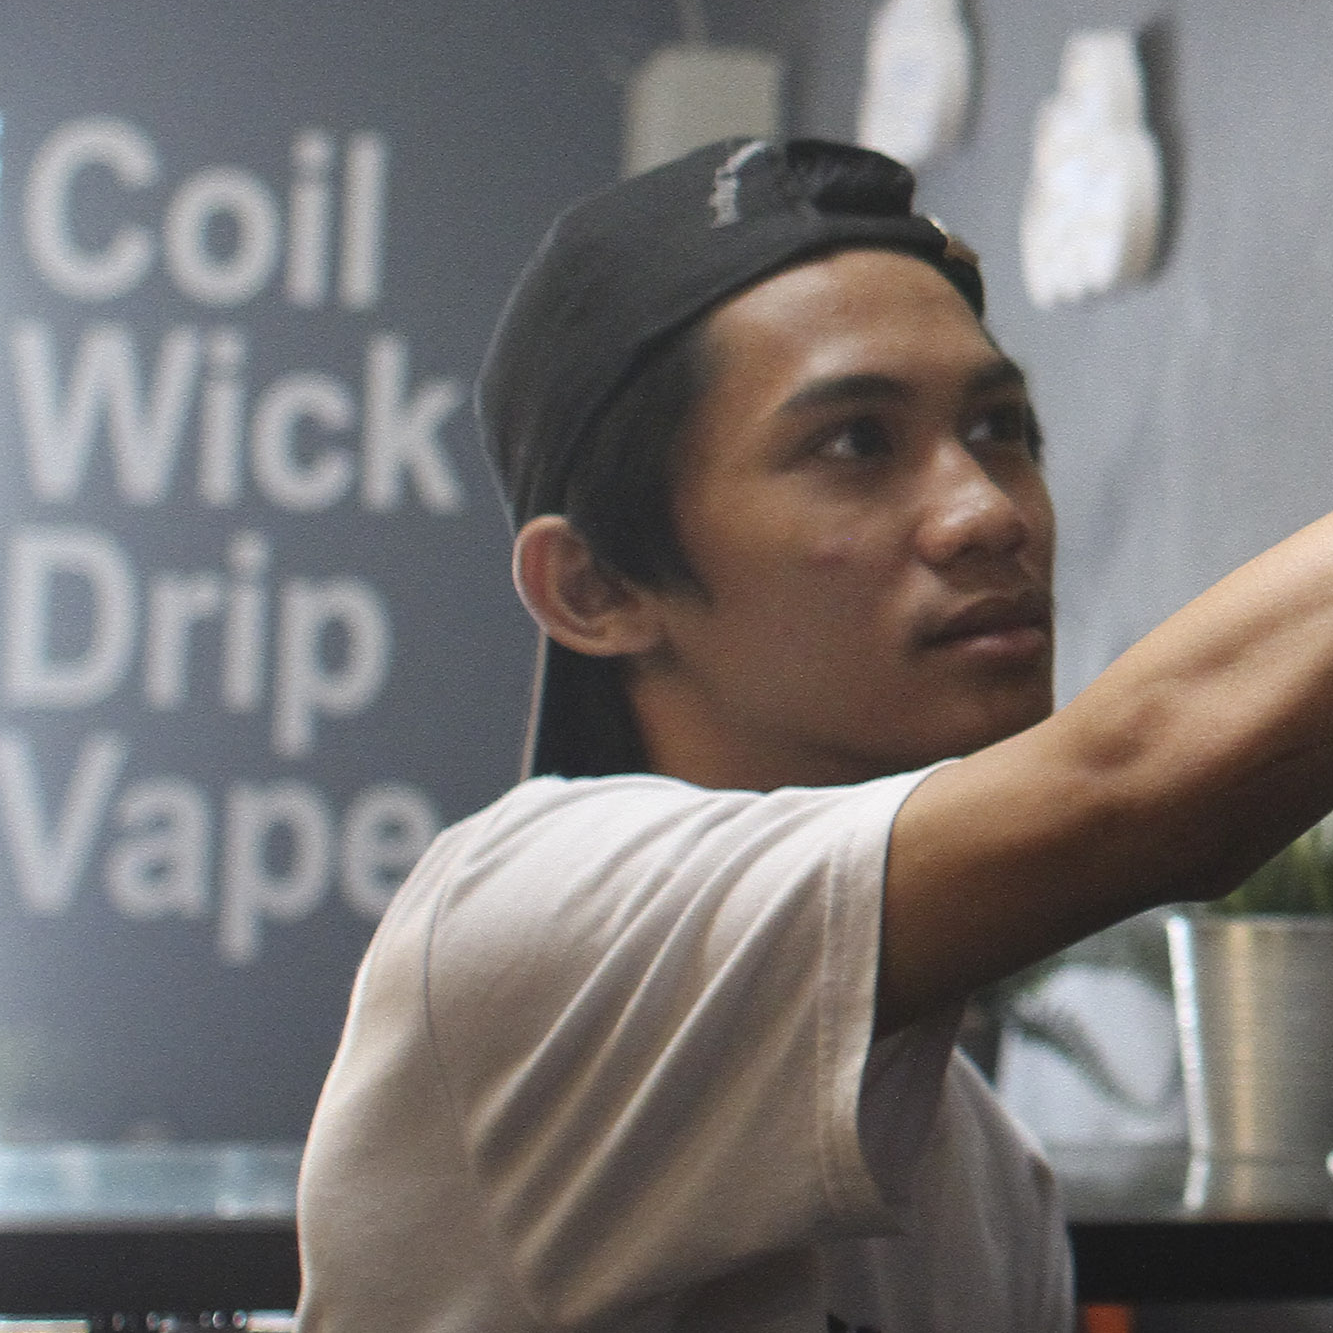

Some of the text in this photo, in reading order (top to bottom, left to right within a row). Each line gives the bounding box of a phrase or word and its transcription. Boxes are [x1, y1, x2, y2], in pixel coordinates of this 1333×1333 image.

[25, 114, 390, 312] Coil
[10, 315, 470, 516] Wick
[2, 530, 391, 758] Drip
[0, 723, 438, 965] Vape
